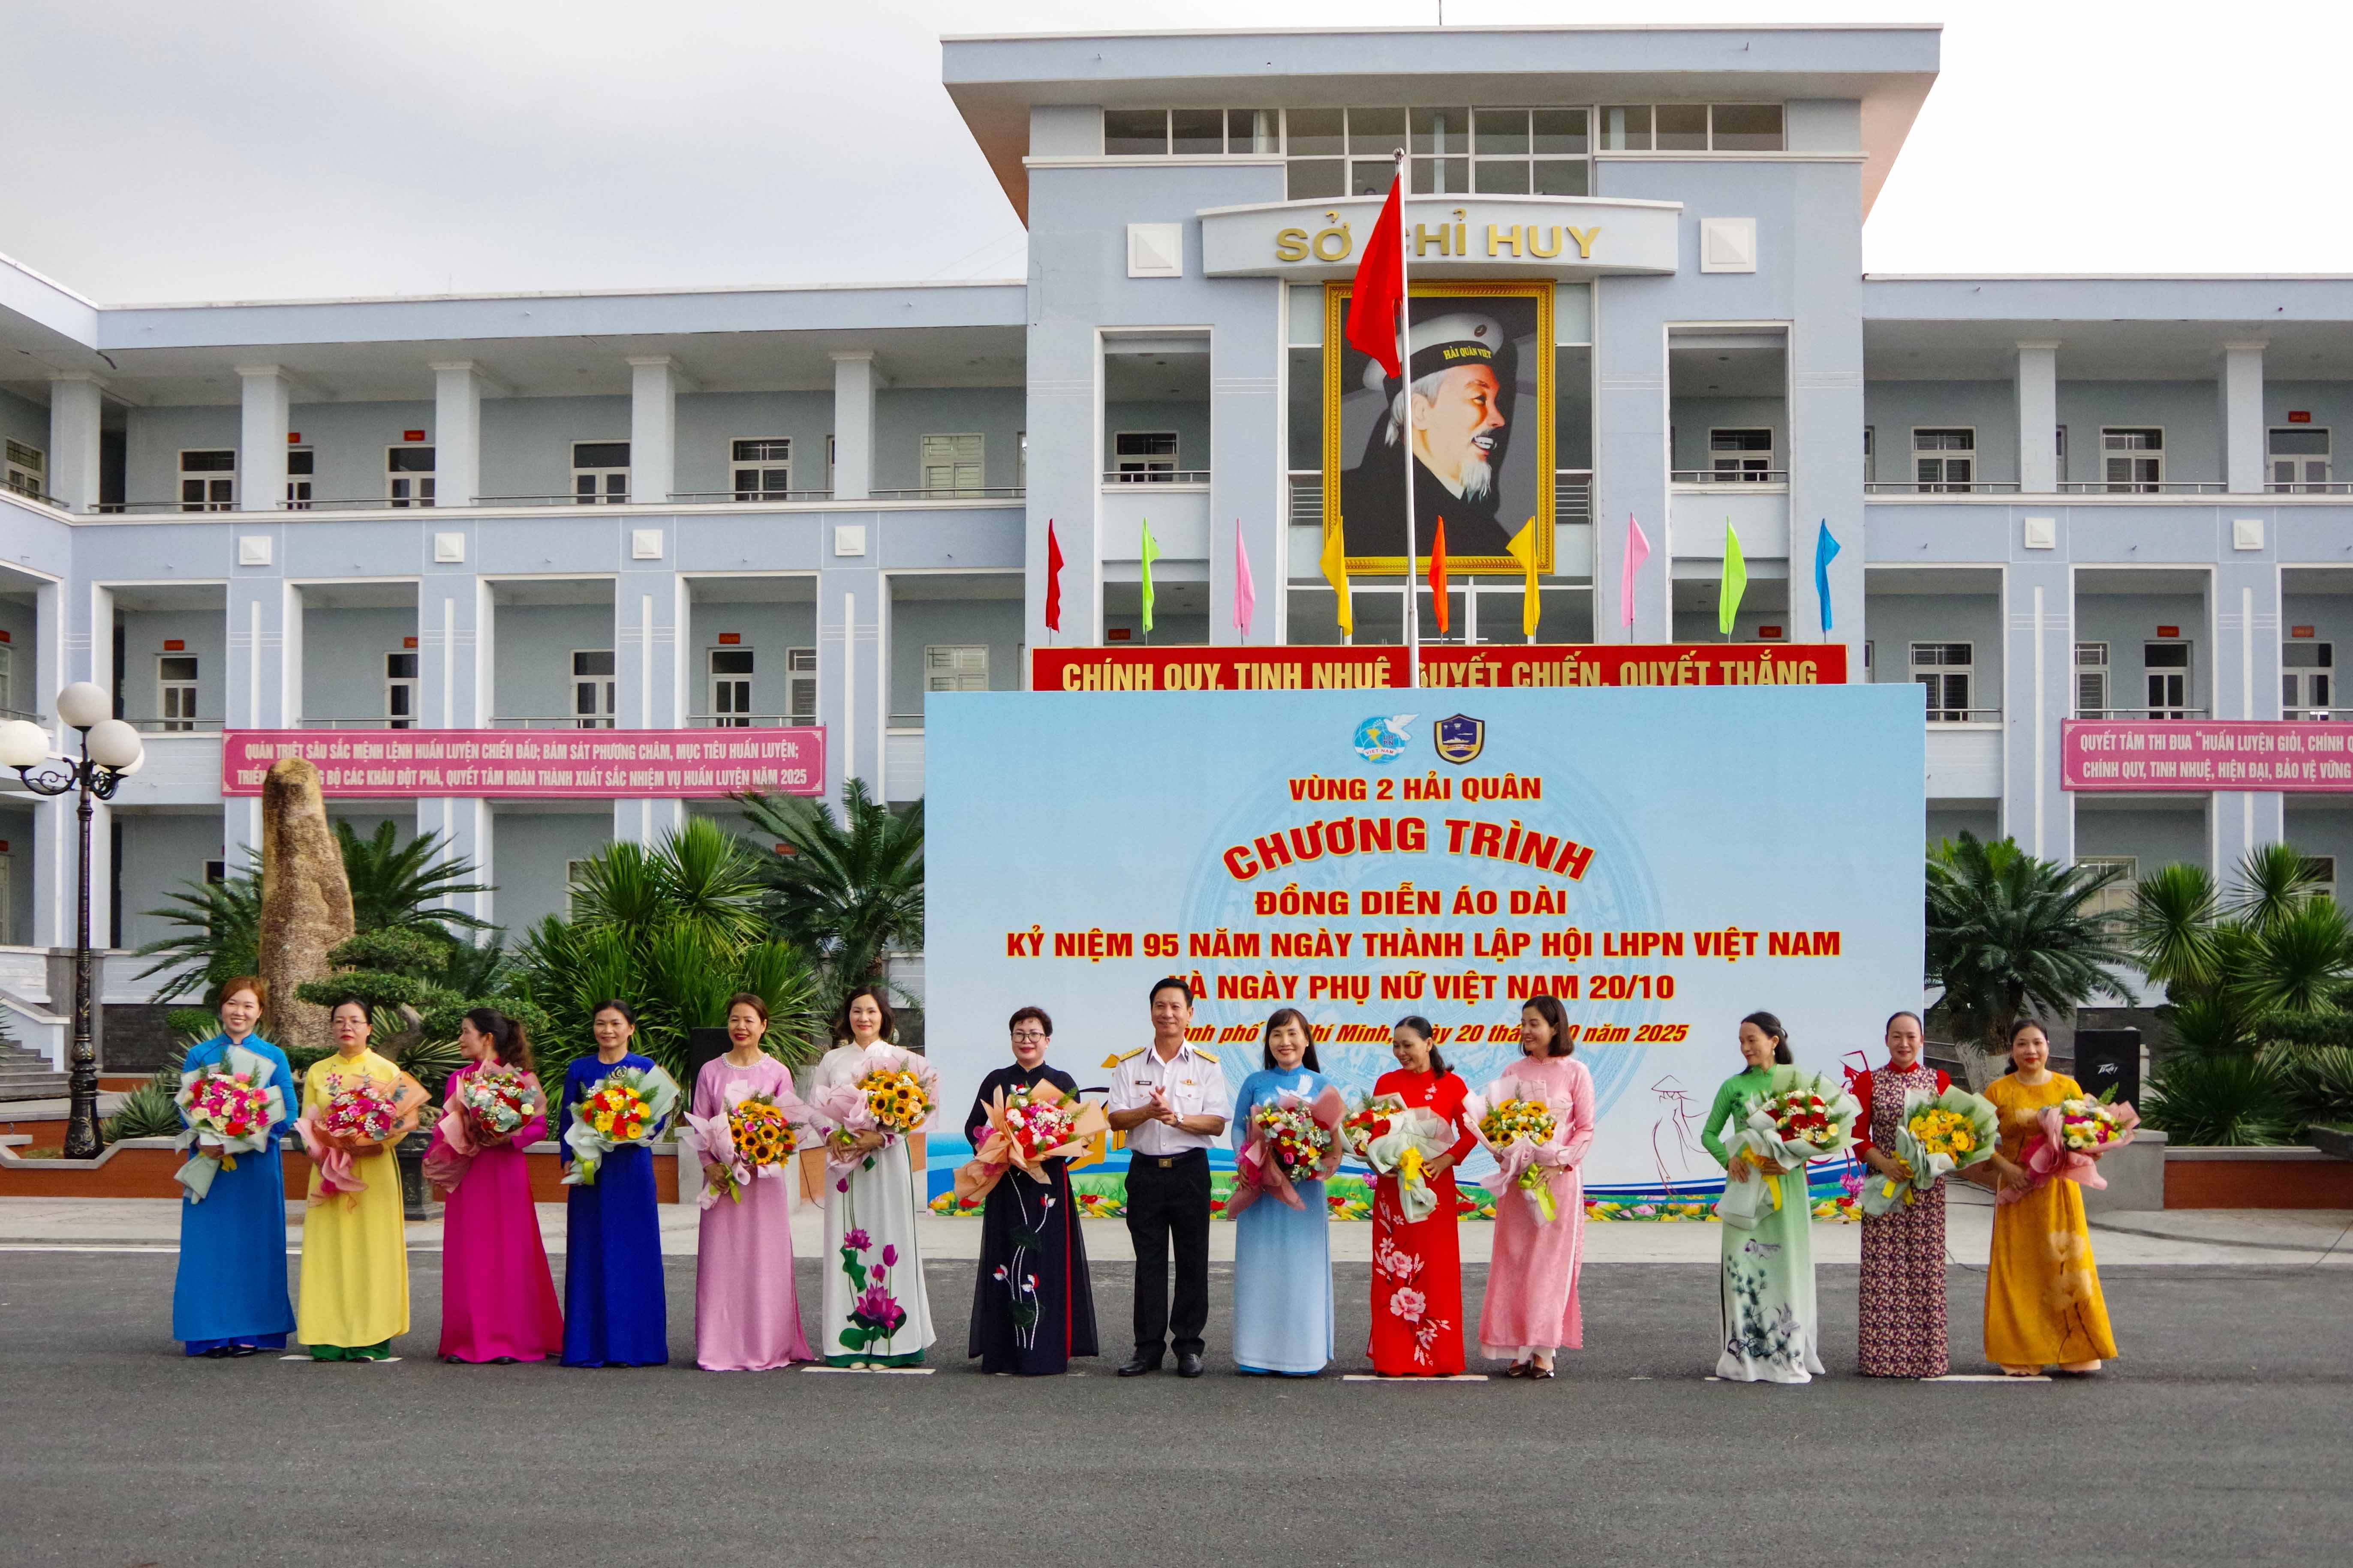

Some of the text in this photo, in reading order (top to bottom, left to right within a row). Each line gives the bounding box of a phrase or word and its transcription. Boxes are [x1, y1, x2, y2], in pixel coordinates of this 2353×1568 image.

[1276, 208, 1600, 260] SỞ HỈ HUY
[1443, 345, 1459, 360] HẢI
[1459, 345, 1478, 357] QUÂN
[1063, 658, 1154, 691] CHÍNH
[1234, 663, 1301, 690] TINH
[1620, 651, 1710, 686] QUYẾT
[1720, 649, 1818, 685] THẮNG
[305, 741, 327, 759] SÂU
[329, 738, 351, 760] SẮC
[352, 740, 384, 763] MỆNH
[385, 740, 413, 763] LỆNH
[415, 738, 445, 759] HUẤN
[445, 740, 480, 763] LUYỆN
[481, 739, 514, 760] CHIẾN
[542, 740, 568, 760] BÁM
[569, 740, 591, 760] SÁT
[592, 742, 636, 760] PHƯƠNG
[638, 741, 674, 762] CHÂM,
[675, 743, 701, 763] MỤC
[703, 740, 727, 759] TIÊU
[729, 737, 759, 760] HUẤN
[2080, 729, 2117, 753] QUYẾT
[2119, 730, 2145, 751] TÂM
[2147, 734, 2166, 751] THI
[2169, 734, 2193, 751] ĐUA
[2237, 732, 2275, 755] LUYỆN
[2277, 730, 2305, 754] GIỎI,
[2308, 732, 2344, 752] CHÍNH
[326, 767, 341, 789] BỘ
[343, 767, 365, 785] CÁC
[367, 767, 395, 785] KHÂU
[396, 766, 418, 789] ĐỘT
[419, 766, 444, 787] PHÁ,
[445, 765, 479, 787] QUYẾT
[480, 766, 504, 786] TÂM
[506, 767, 536, 786] HOÀN
[537, 767, 573, 786] THÀNH
[575, 765, 603, 787] XUẤT
[605, 764, 627, 787] SẮC
[629, 767, 665, 790] NHIỆM
[666, 770, 681, 790] VỤ
[683, 764, 714, 786] HUẤN
[716, 766, 750, 789] LUYỆN
[752, 766, 778, 785] NĂM
[780, 769, 807, 785] 2025
[2082, 757, 2351, 782] CHÍNH QUY, TINH NHUỆ, HIỆN ĐẠI, BẢO VỆ VỮNG
[1289, 771, 1541, 802] VÙNG 2 HẢI QUÂN
[1223, 816, 1594, 881] CHƯƠNG TRÌNH
[1255, 882, 1566, 915] ĐỒNG DIỄN ÁO DÀI
[1008, 925, 1840, 962] KỶ NIỆM 95 NĂM NGÀY THÀNH LẬP HỘI LHPN VIỆT NAM
[1169, 970, 1674, 1005] À NGÀY PHỤ NỮ VIỆT NAM 20/10
[1218, 1021, 1265, 1044] phố
[1308, 1024, 1333, 1042] hí
[1336, 1024, 1393, 1043] Minh,
[1454, 1024, 1485, 1042] 20
[1487, 1024, 1522, 1042] thá
[1567, 1024, 1580, 1042] 0
[1582, 1024, 1631, 1042] năm
[1633, 1024, 1689, 1042] 2025
